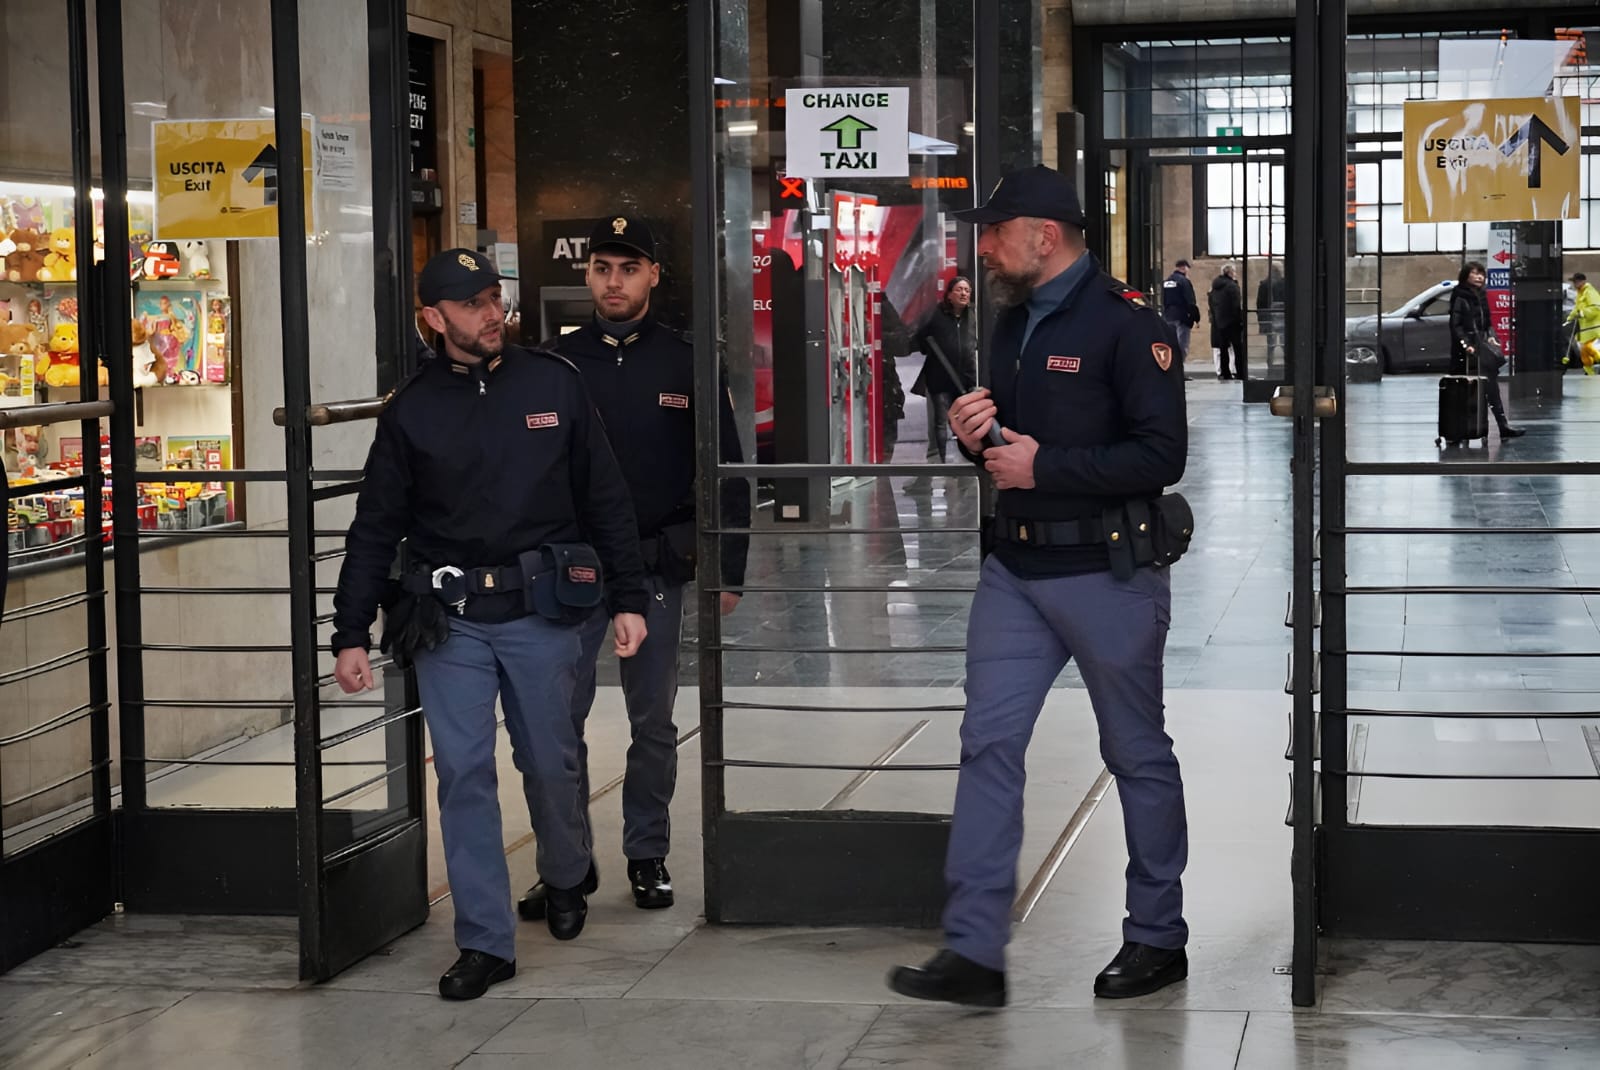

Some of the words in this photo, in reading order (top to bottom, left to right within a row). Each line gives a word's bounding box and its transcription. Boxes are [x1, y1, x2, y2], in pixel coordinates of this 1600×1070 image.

[802, 93, 889, 108] CHANGE
[1424, 136, 1489, 152] USCITA
[820, 152, 877, 169] TAXI
[169, 161, 226, 176] USCITA
[185, 179, 211, 192] Exit
[552, 237, 591, 259] AT
